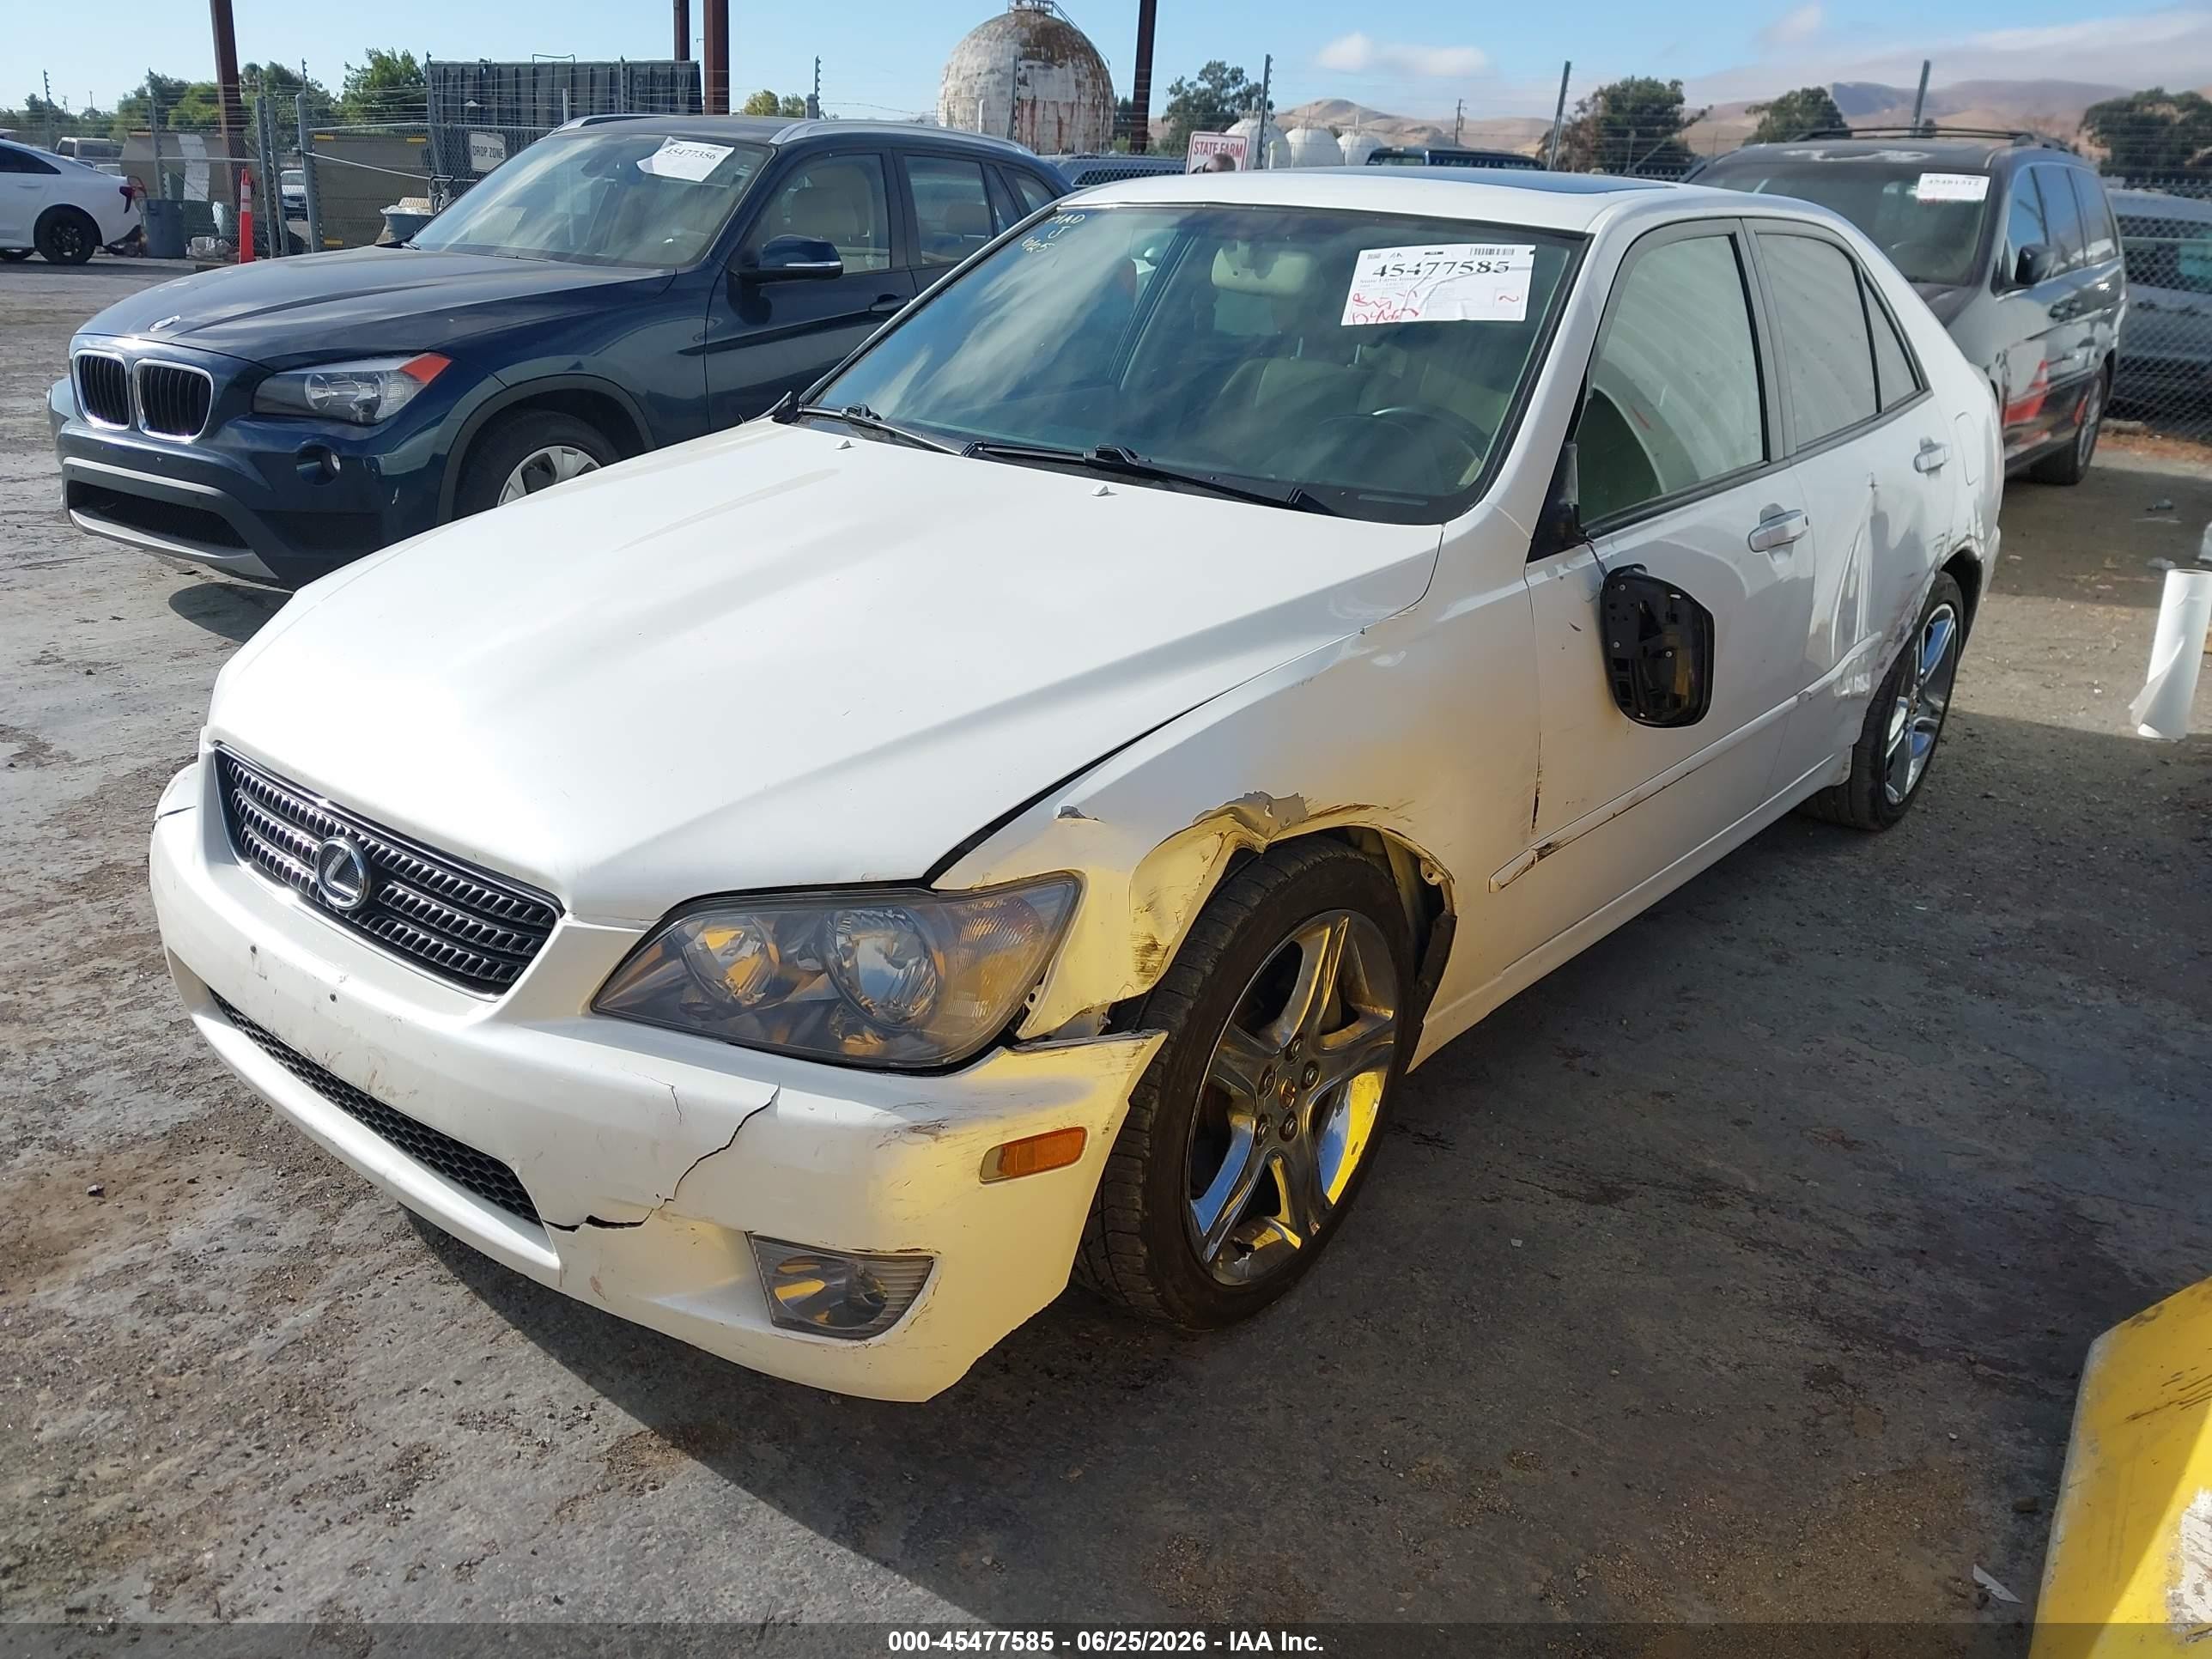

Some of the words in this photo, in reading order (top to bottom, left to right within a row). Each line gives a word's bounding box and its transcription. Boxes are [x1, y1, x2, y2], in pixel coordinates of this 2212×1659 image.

[472, 144, 488, 157] DROP
[489, 145, 504, 159] ZONE
[1194, 141, 1218, 156] STATE
[1219, 142, 1243, 158] FARM
[1372, 260, 1510, 277] 45477585
